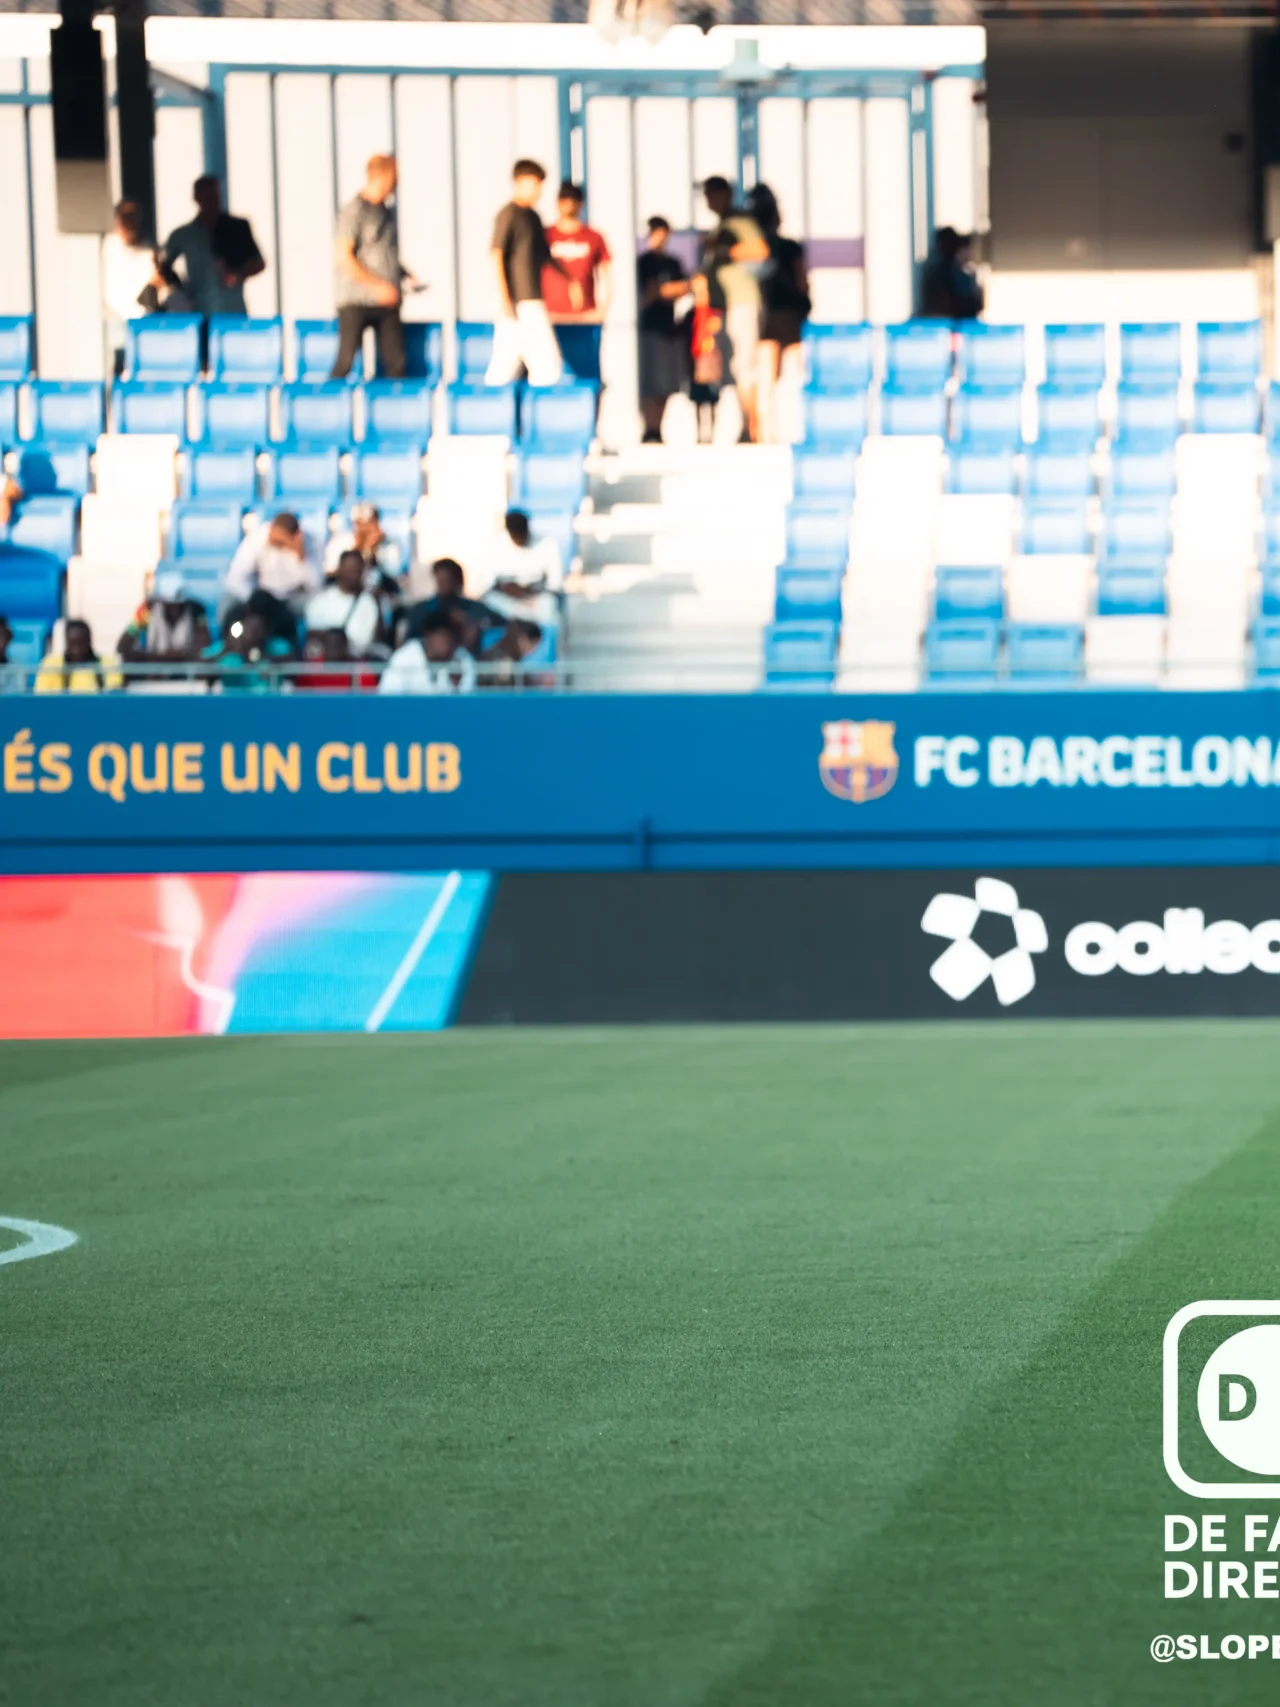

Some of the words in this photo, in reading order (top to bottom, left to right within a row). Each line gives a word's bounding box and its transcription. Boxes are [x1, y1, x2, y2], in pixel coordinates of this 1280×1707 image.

[3, 728, 73, 793] ÉS
[88, 743, 204, 803] QUE
[220, 742, 301, 793] UN
[316, 742, 461, 793] CLUB
[914, 736, 979, 787] FC
